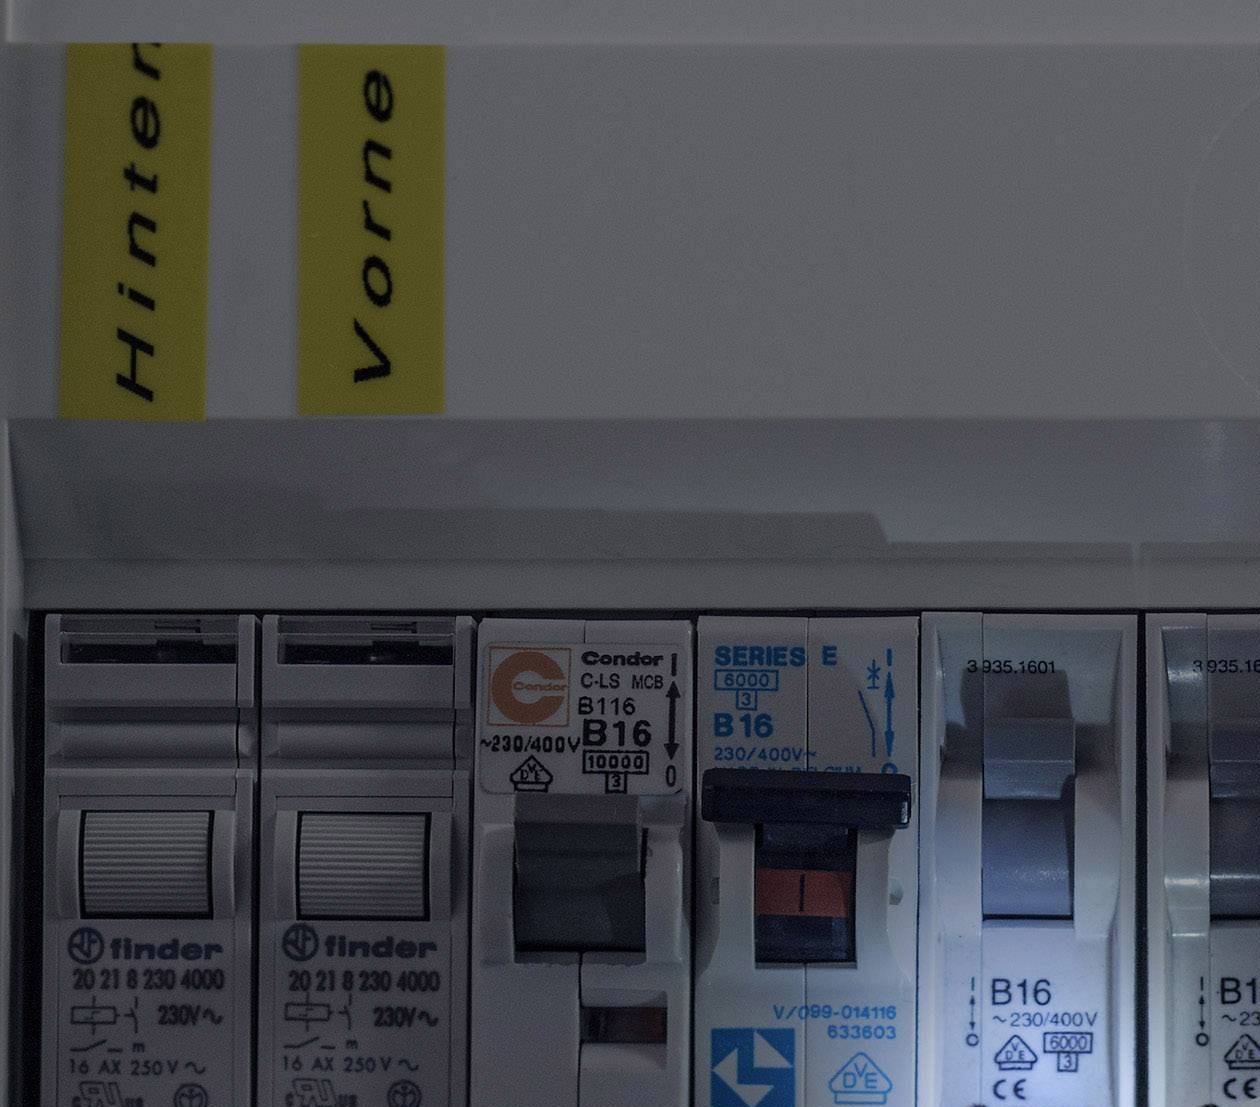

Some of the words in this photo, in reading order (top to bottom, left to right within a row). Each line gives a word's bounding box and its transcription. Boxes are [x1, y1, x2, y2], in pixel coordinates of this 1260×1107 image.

[353, 70, 394, 384] Vorne
[581, 651, 664, 666] Condor
[714, 645, 807, 667] SERIES
[821, 645, 838, 667] E
[513, 681, 568, 691] Condor
[631, 675, 664, 690] MCB
[724, 673, 770, 687] 6000
[578, 696, 636, 716] B116
[741, 692, 752, 706] 3
[582, 719, 651, 747] B16
[588, 755, 644, 769] 10000
[611, 774, 621, 787] 3
[111, 938, 223, 960] finder
[325, 935, 437, 958] finder
[73, 969, 95, 990] 20
[143, 969, 176, 990] 230
[180, 969, 225, 990] 4000
[289, 970, 311, 992] 20
[358, 970, 391, 992] 230
[396, 970, 441, 992] 4000
[992, 978, 1052, 1006] B16
[827, 1024, 897, 1040] 633603
[1050, 1036, 1088, 1050] 6000
[70, 1059, 89, 1075] 16
[98, 1060, 121, 1075] AX
[131, 1060, 162, 1075] 250
[167, 1060, 178, 1074] V
[283, 1056, 302, 1071] 16
[311, 1056, 334, 1071] AX
[343, 1057, 375, 1072] 250
[380, 1057, 391, 1071] V
[1064, 1055, 1073, 1069] 3
